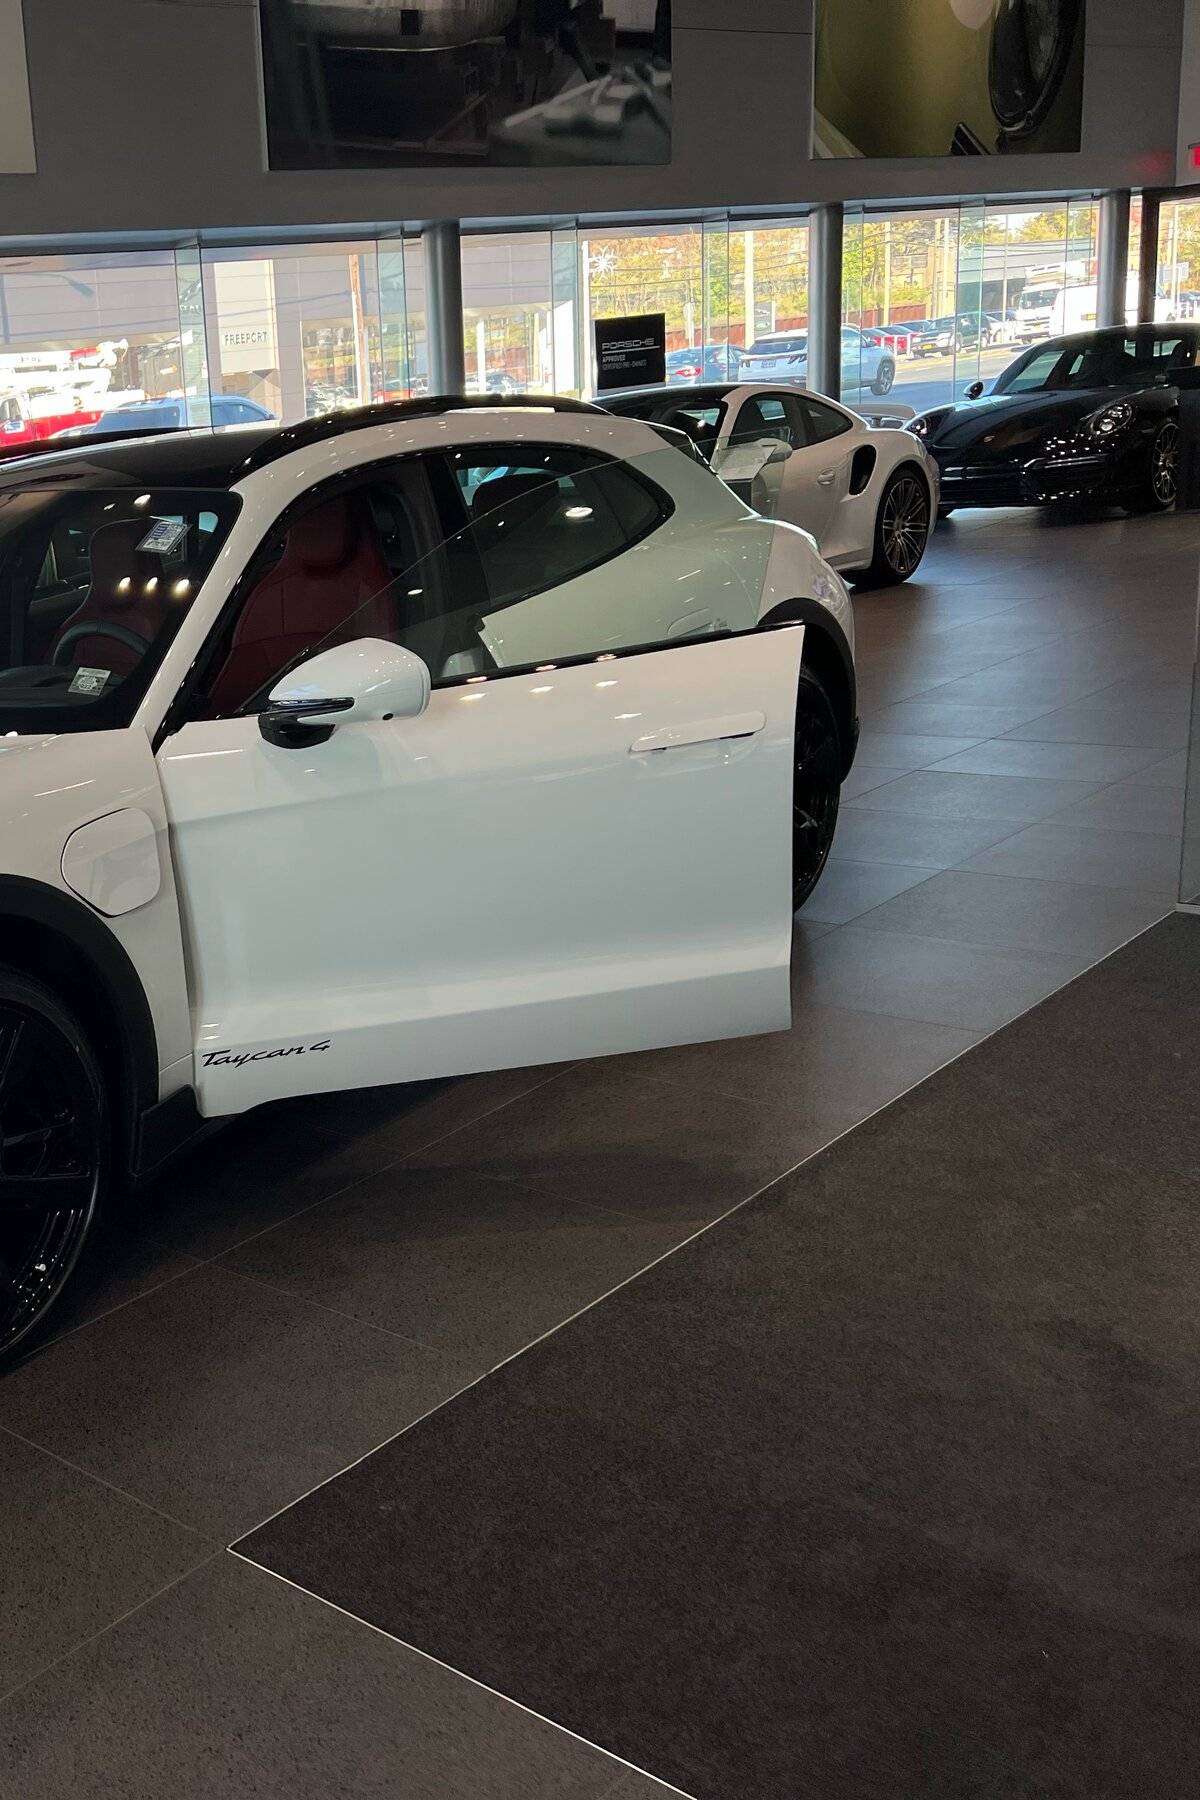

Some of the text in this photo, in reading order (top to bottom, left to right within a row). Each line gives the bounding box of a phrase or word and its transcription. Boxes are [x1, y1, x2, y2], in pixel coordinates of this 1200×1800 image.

[224, 331, 268, 346] FREEPORT
[601, 337, 655, 351] PORSCHE
[202, 1039, 332, 1069] Taycan 4
